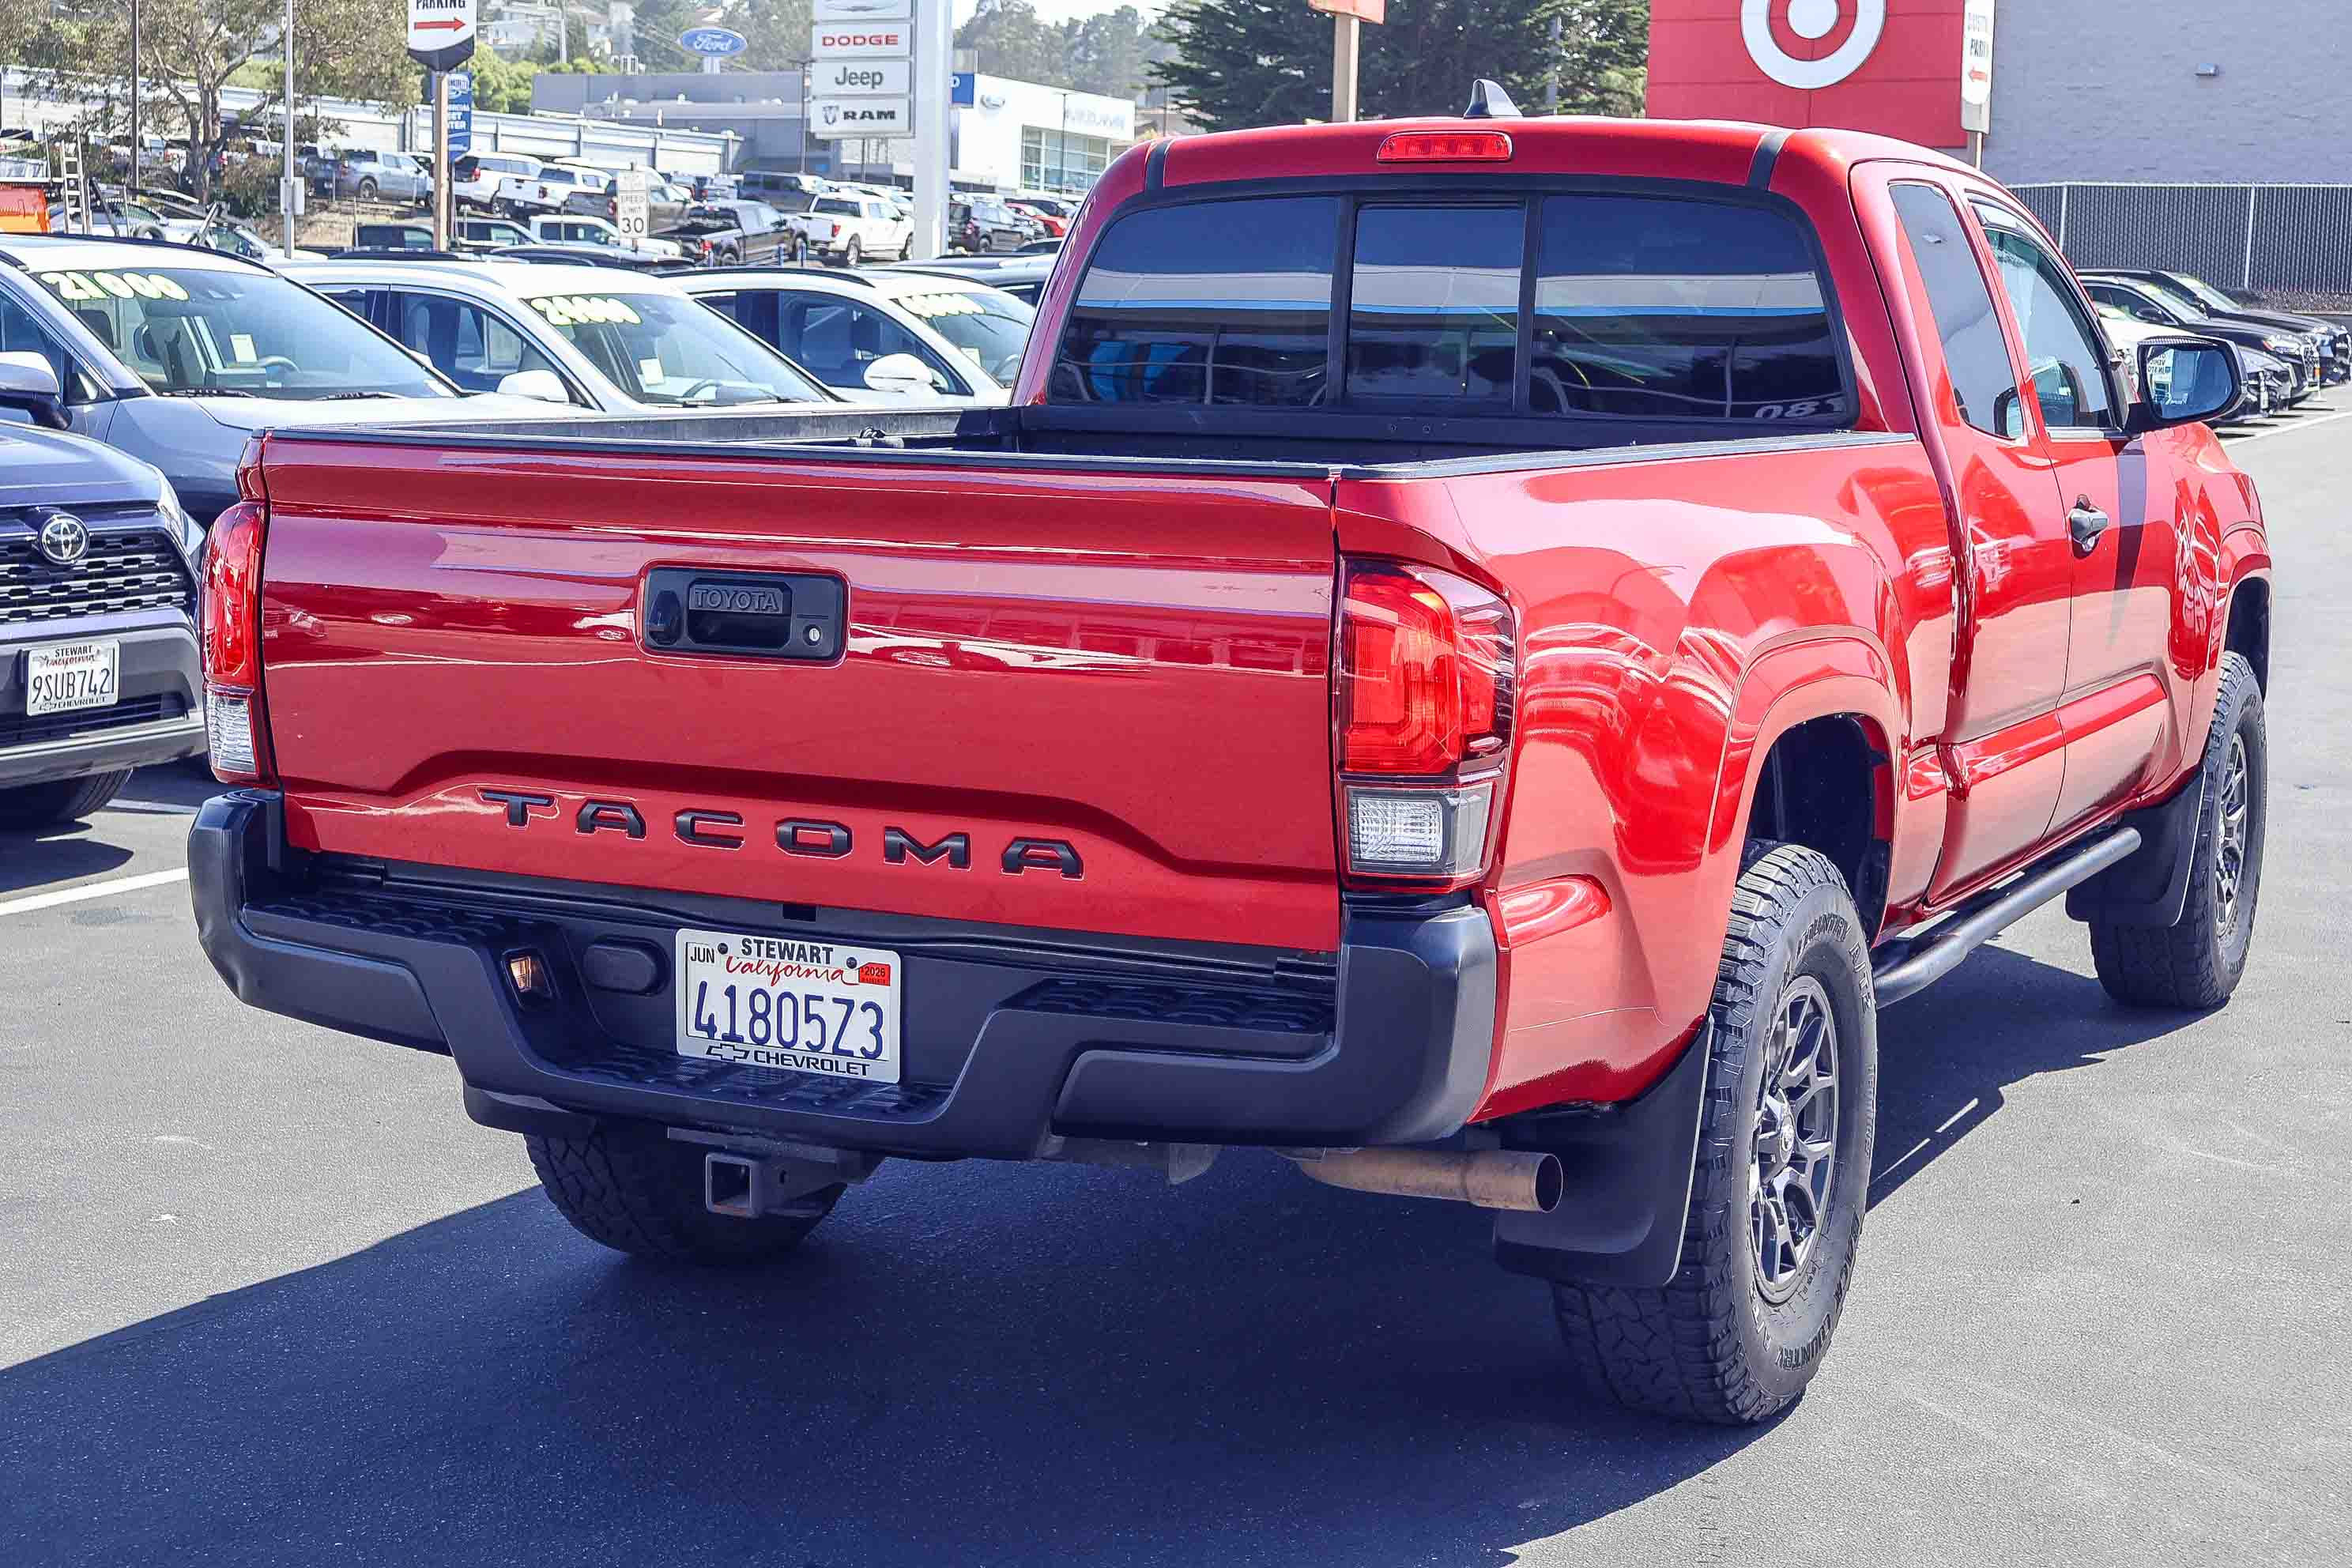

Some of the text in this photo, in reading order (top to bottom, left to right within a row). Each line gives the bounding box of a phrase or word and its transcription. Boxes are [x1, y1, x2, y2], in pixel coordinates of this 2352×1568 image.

[822, 34, 899, 46] DODGE
[835, 65, 884, 89] Jeep
[843, 109, 896, 121] RAM
[621, 217, 645, 234] 30
[694, 587, 780, 612] TOYOTA
[55, 645, 93, 658] STEWART
[32, 667, 111, 704] 9SUB742
[479, 790, 1084, 880] TACOMA
[690, 946, 715, 964] JUN
[741, 937, 834, 964] STEWART
[726, 956, 860, 986] California
[694, 980, 884, 1059] 41805Z3
[753, 1050, 871, 1076] CHEVROLET
